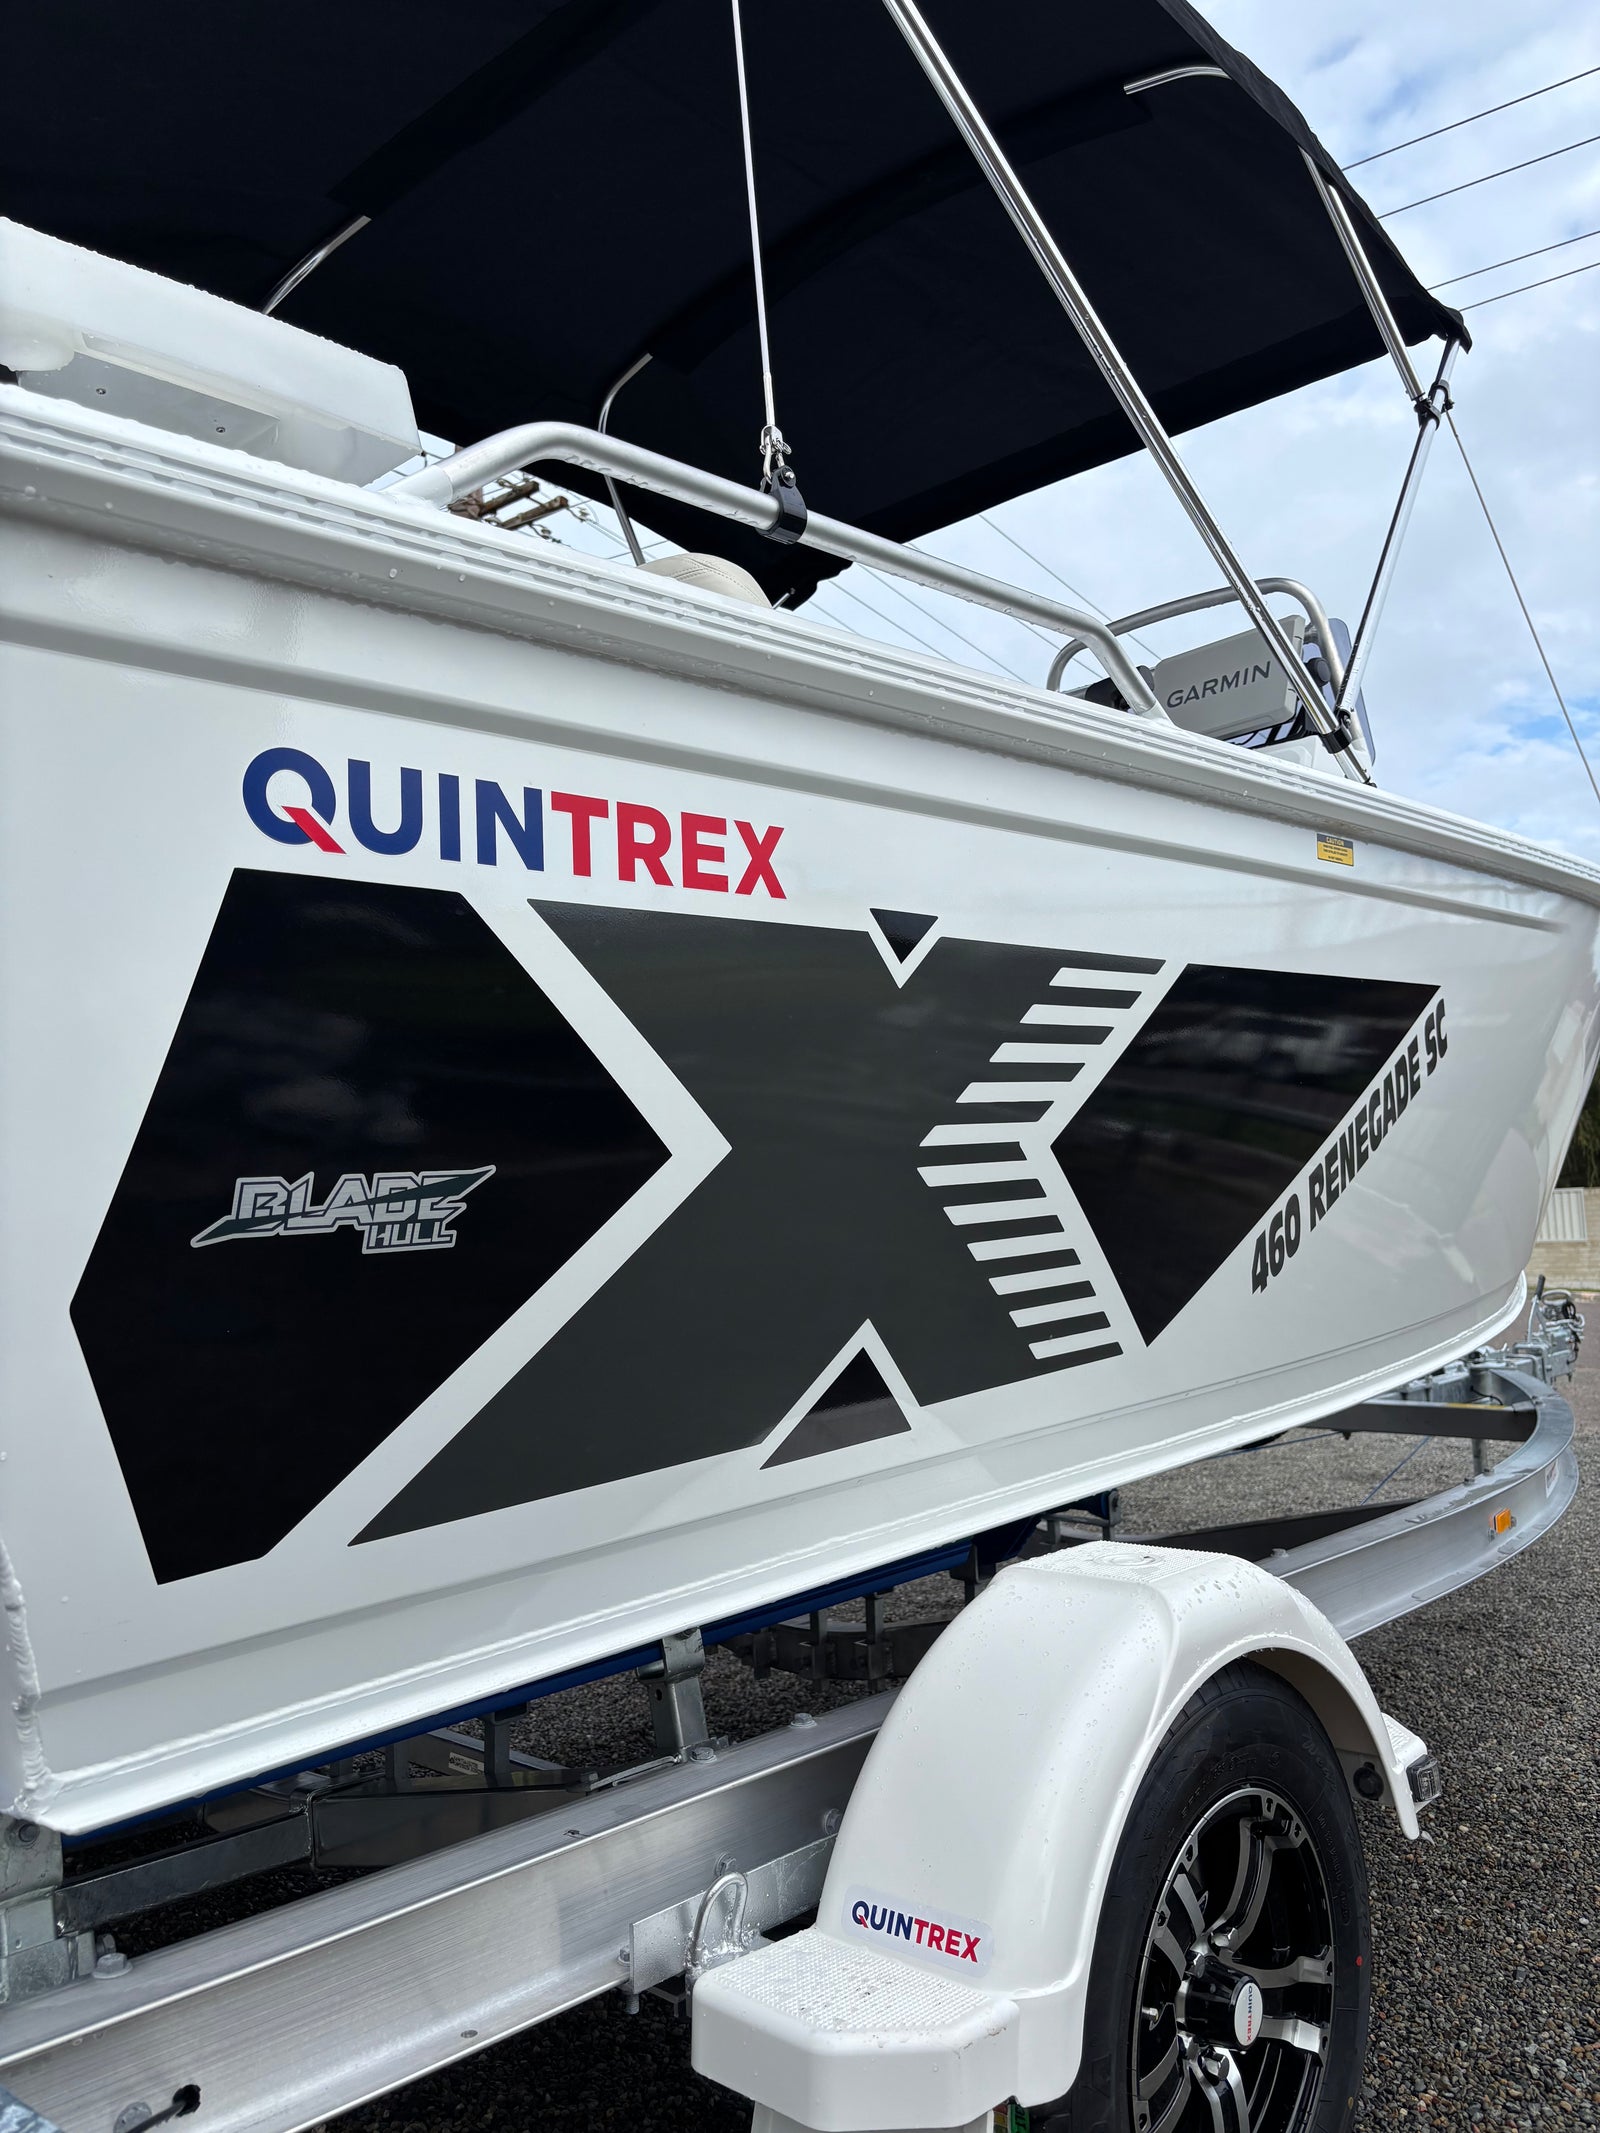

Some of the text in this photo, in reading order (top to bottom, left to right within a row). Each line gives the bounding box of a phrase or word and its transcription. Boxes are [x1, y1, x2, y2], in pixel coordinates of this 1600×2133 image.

[1166, 660, 1272, 709] GARMIN
[242, 746, 788, 900] QUINTREX
[1251, 998, 1448, 1295] 460 RENEGADE SC
[191, 1165, 497, 1240] BLADE
[366, 1221, 455, 1250] HULL
[852, 1900, 982, 1964] QUINTREX
